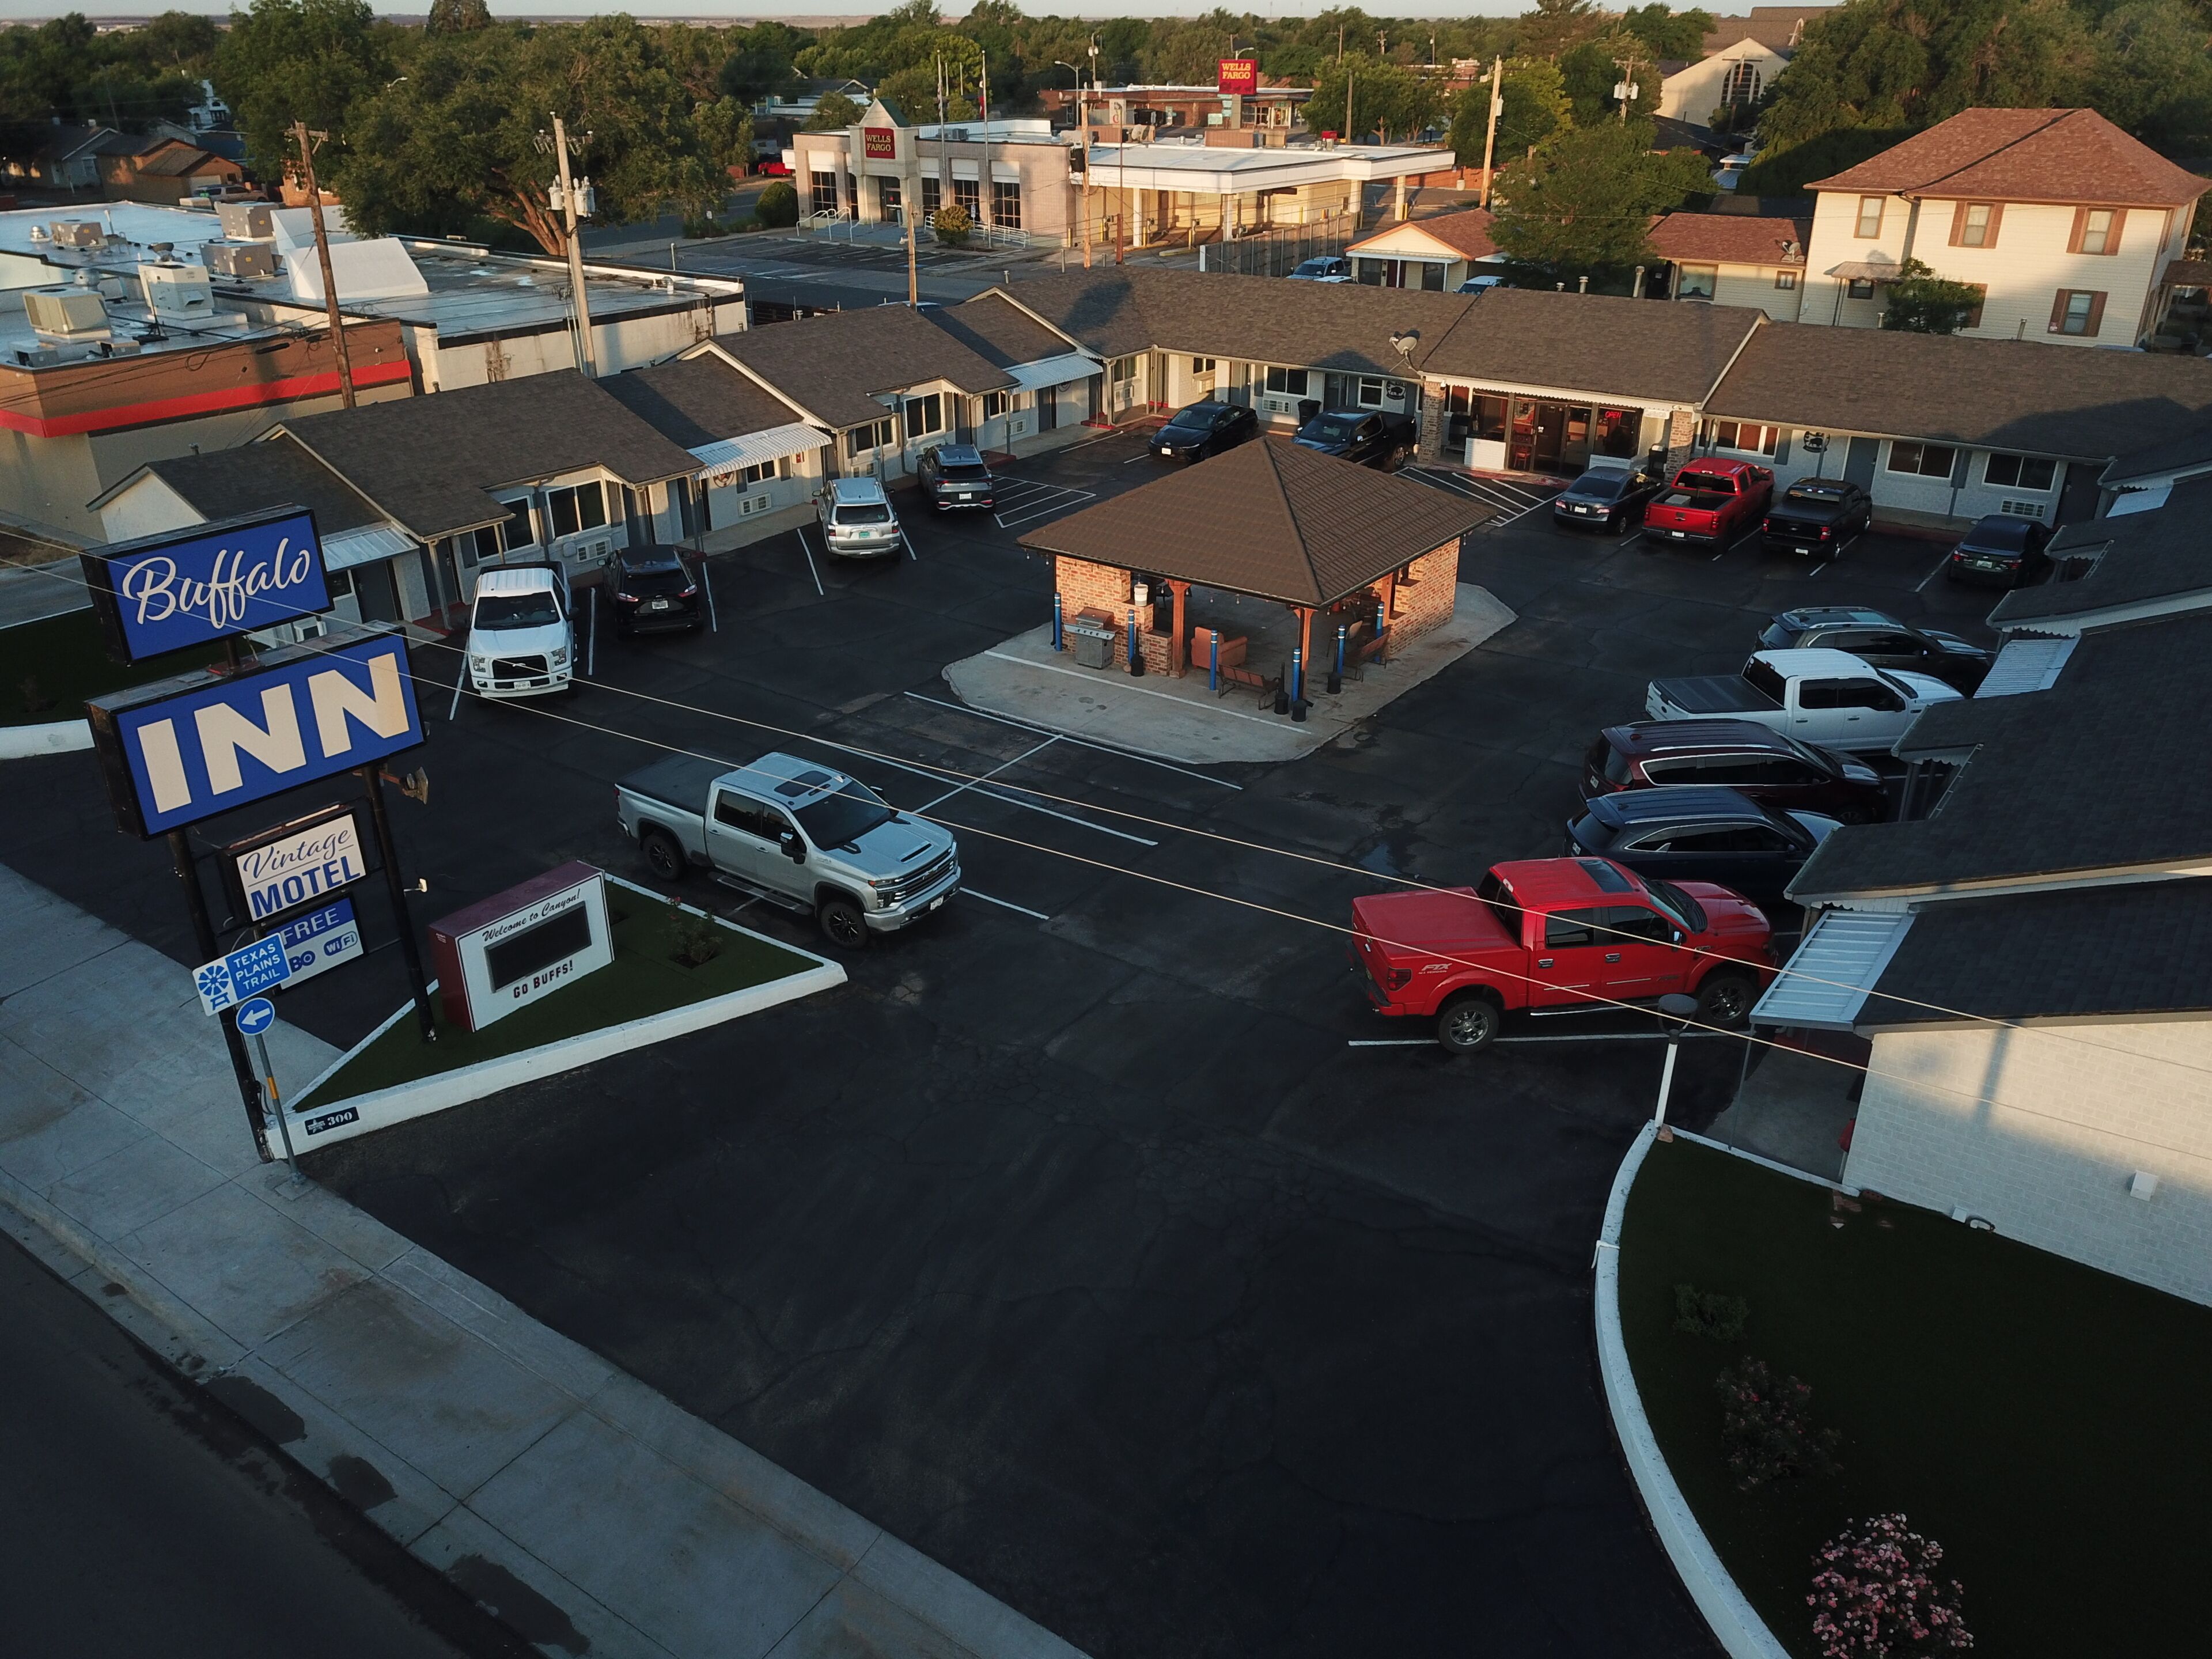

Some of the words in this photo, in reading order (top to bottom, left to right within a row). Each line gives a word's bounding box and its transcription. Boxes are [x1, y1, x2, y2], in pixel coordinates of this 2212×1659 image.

[1222, 63, 1251, 71] WELLS
[1222, 71, 1251, 79] FARGO
[866, 134, 891, 143] WELLS
[867, 143, 891, 151] FARGO
[122, 537, 310, 629] Buffalo
[137, 652, 410, 814] INN
[243, 830, 351, 879] Vintage
[251, 855, 361, 918] MOTEL
[282, 907, 340, 946] FREE
[482, 917, 527, 942] Welcome
[529, 912, 539, 922] to
[541, 888, 581, 917] Canyon!
[233, 943, 276, 968] TEXAS
[235, 955, 281, 981] PLAINS
[289, 950, 316, 973] BO
[243, 968, 281, 991] TRAIL
[513, 983, 528, 998] GO
[533, 960, 574, 989] BUFFS!
[327, 1111, 353, 1126] 300
